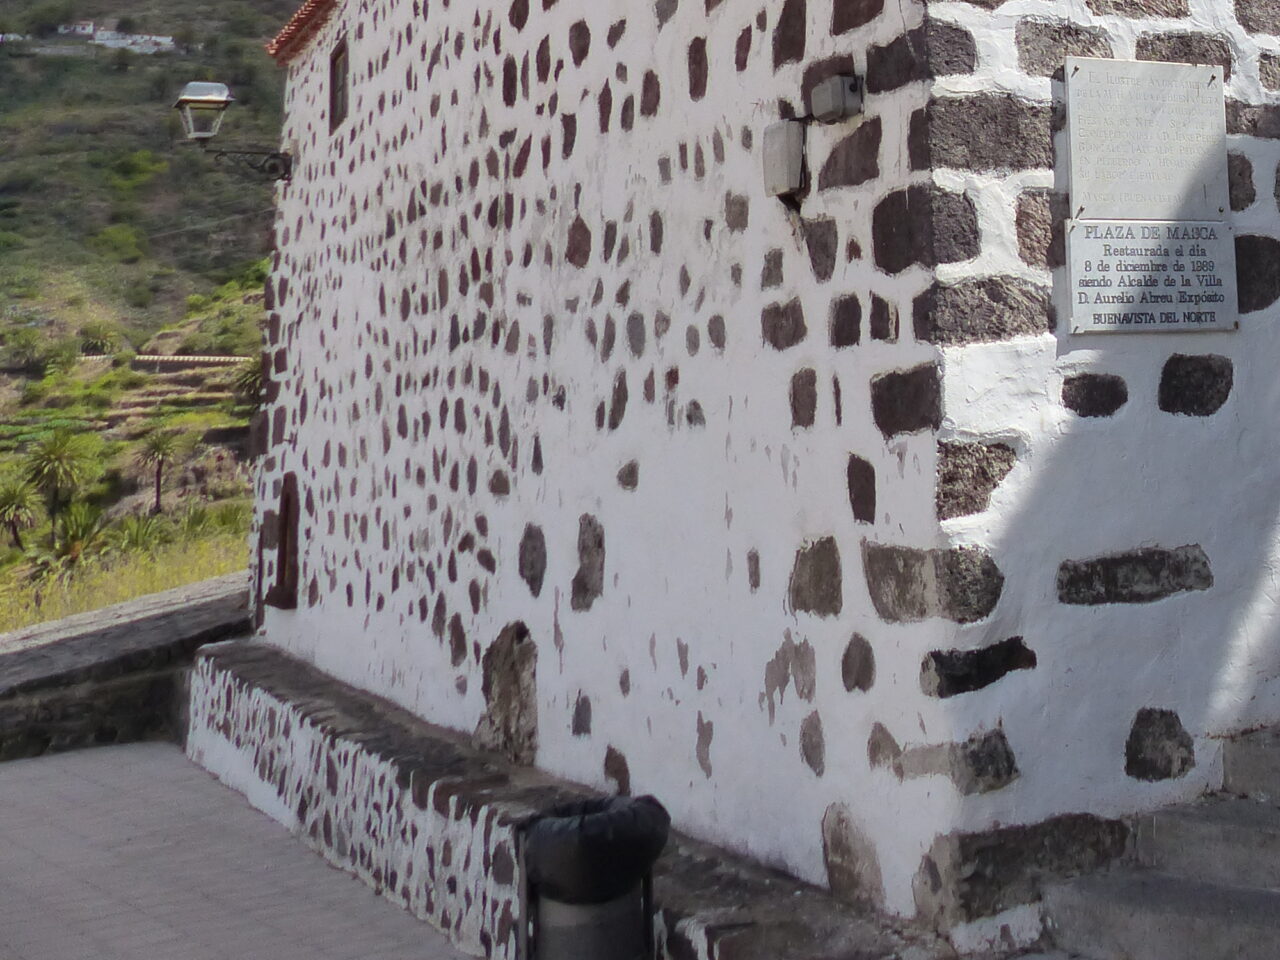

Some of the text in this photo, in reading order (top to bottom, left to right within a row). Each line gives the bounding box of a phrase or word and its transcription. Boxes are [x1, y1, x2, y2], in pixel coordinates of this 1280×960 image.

[1084, 226, 1218, 240] PLAZA DE MASCA
[1103, 244, 1170, 256] Restaurada
[1175, 245, 1184, 256] el
[1084, 260, 1092, 272] 8
[1097, 260, 1110, 272] de
[1116, 260, 1167, 272] diciembre
[1173, 260, 1185, 272] de
[1078, 275, 1222, 287] siendo Alcalde de la Villa
[1094, 292, 1134, 304] Aurelio
[1139, 292, 1173, 304] Abreu
[1093, 311, 1216, 324] BUENAVISTA DEL NORTE
